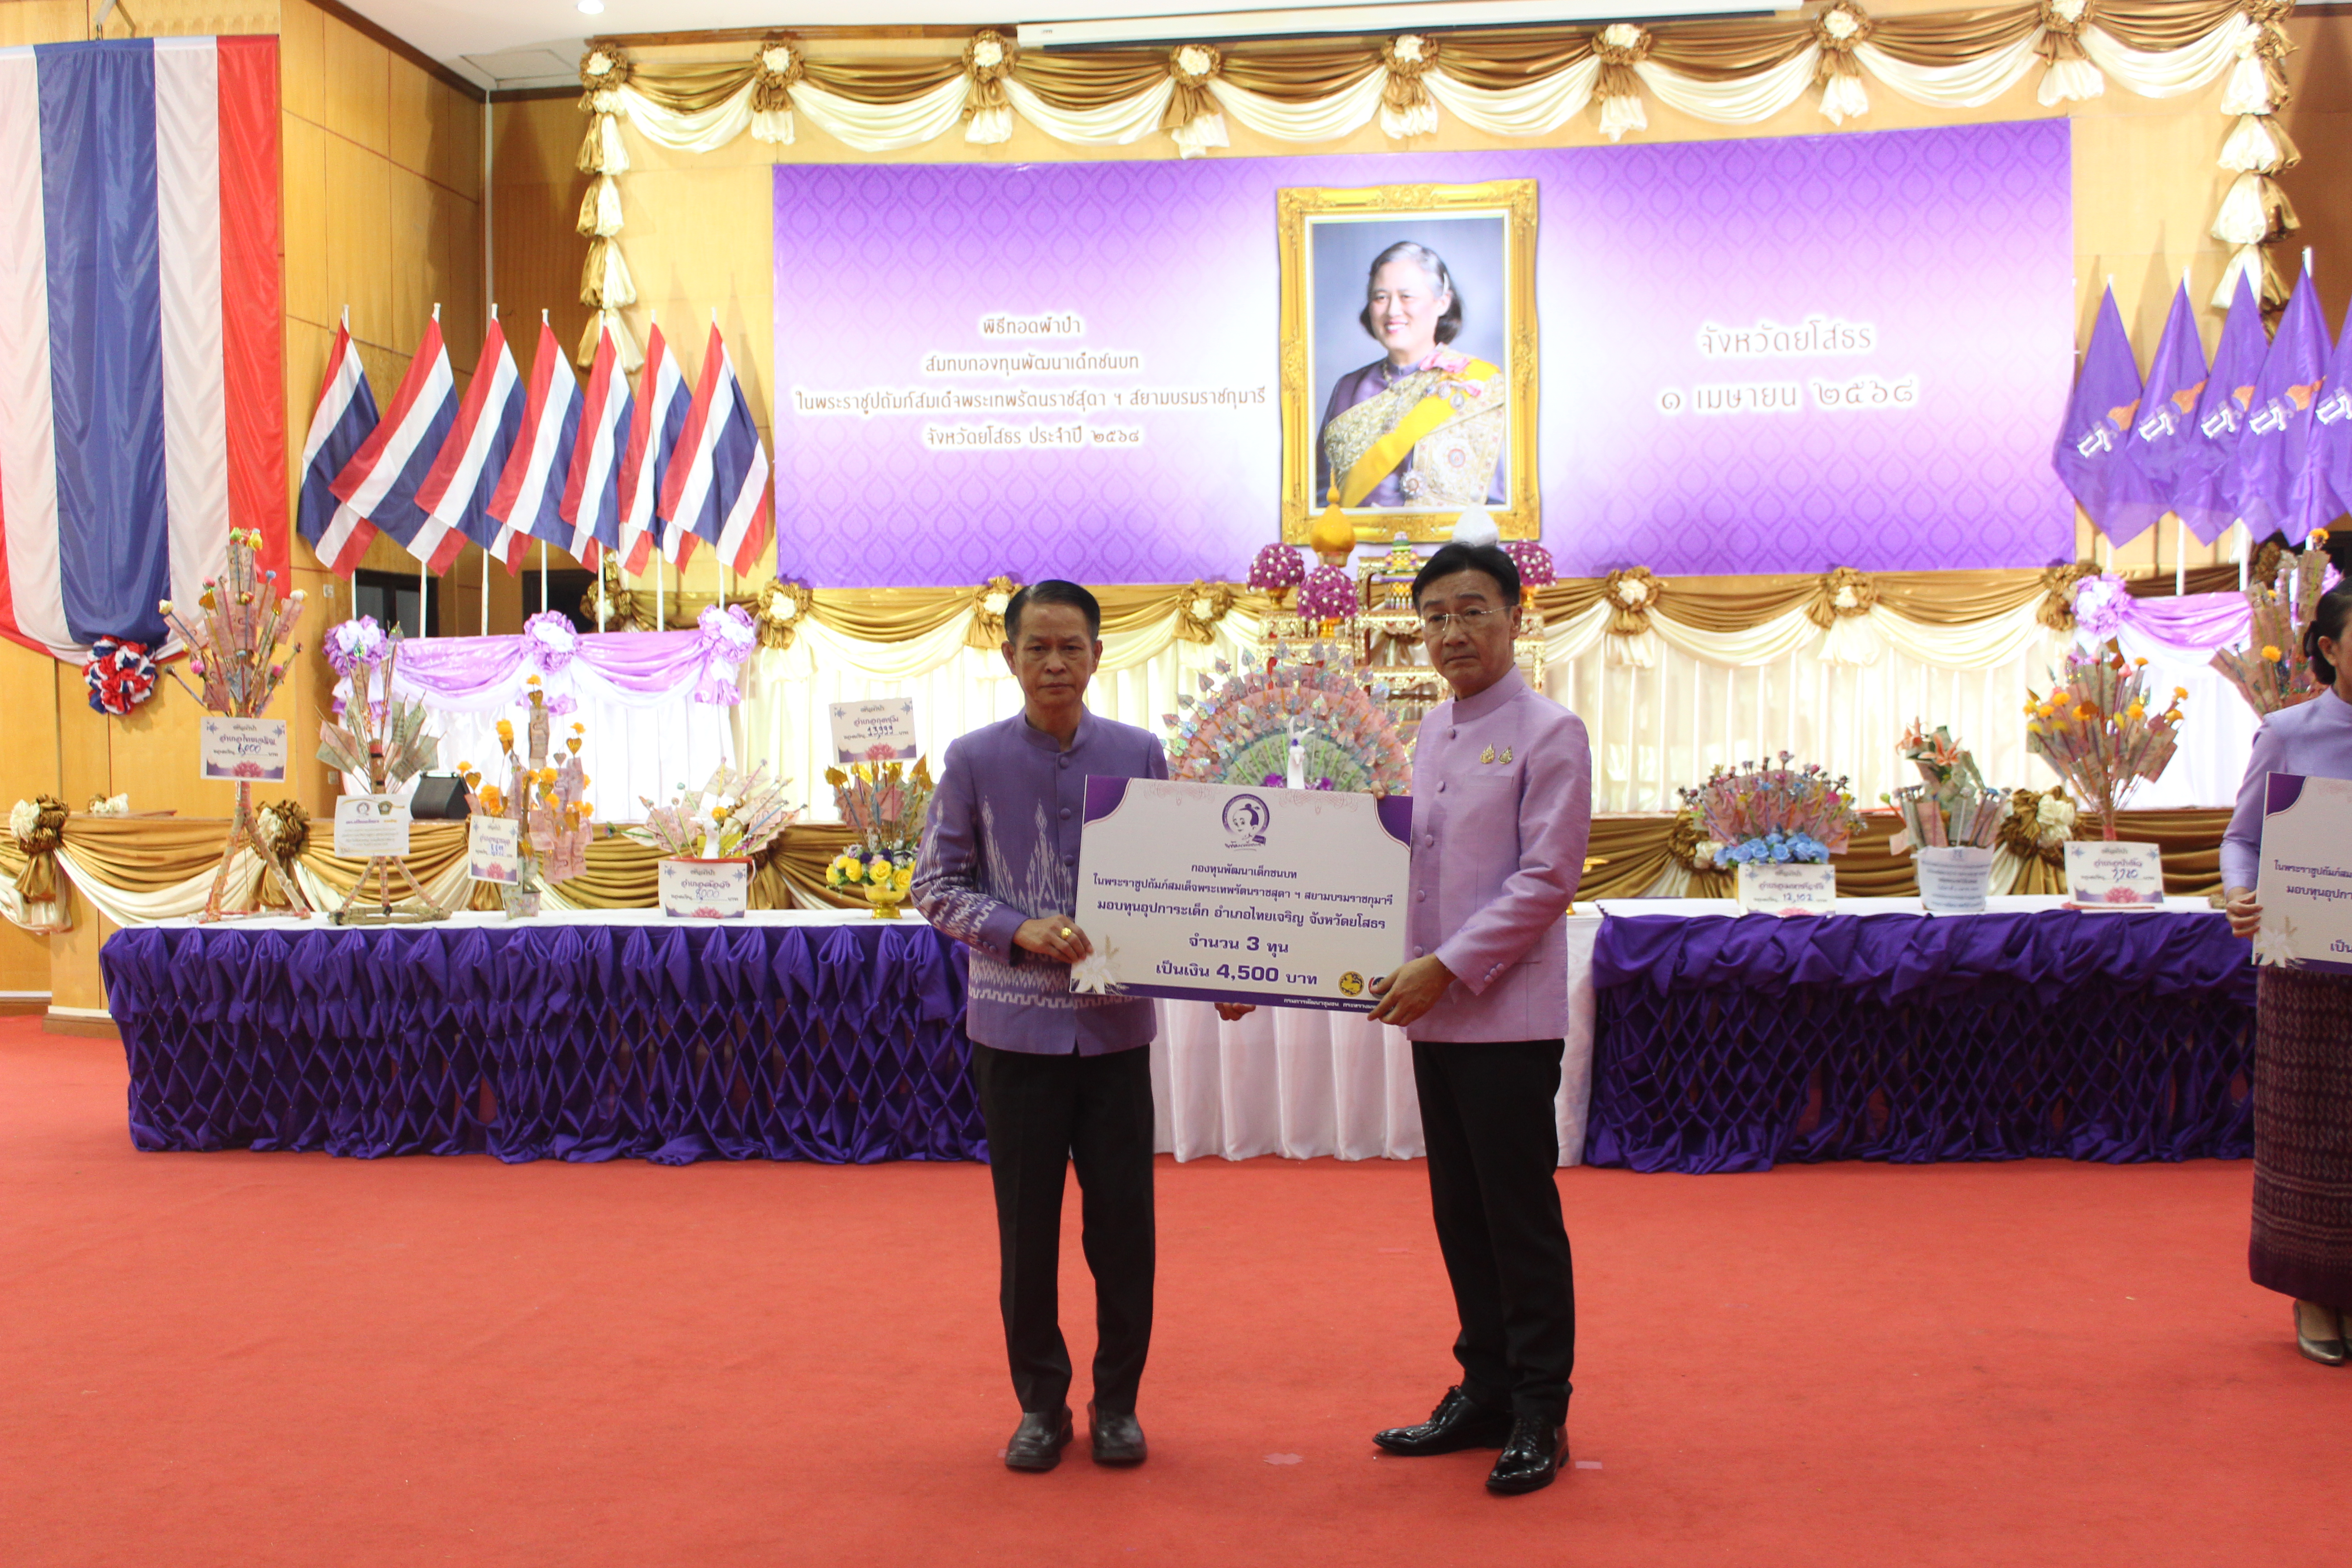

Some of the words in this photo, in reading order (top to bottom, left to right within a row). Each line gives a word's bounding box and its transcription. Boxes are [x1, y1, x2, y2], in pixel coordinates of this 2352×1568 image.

[983, 316, 1081, 335] พิธีทอดผ้าป่า
[1701, 319, 1872, 353] จังหวัดยโสธร
[926, 352, 1139, 376] สมทบกองทุนพัฒนาเด็กชนบท
[796, 388, 1106, 414] ในพระราชูปถัมภ์สมเด็จพระเทพรัตนราชสุดา
[1114, 394, 1122, 406] ฯ
[1130, 386, 1266, 409] สยามบรมราชกุมารี
[1661, 392, 1681, 410] ๑
[1697, 386, 1797, 409] เมษายน
[1813, 379, 1913, 405] ๒๕๖๘
[927, 426, 1021, 445] จังหวัดยโสธร
[1029, 426, 1083, 444] ประจำปี
[1090, 429, 1139, 443] ๒๕๖๘
[1191, 863, 1297, 879] กองทุนพัฒนาเด็กชนบท
[1093, 872, 1290, 902] ในพระราชูปถัมภ์สมเด็จพระเทพรัตนราชสุดา
[1304, 891, 1393, 908] สยามบรมราชกุมารี
[1097, 900, 1209, 917] มอบทุนอุปการะเด็ก
[1215, 905, 1304, 926] อำเภอไทยเจริญ
[1309, 911, 1385, 929] จังหวัดยโสธร
[1189, 932, 1239, 949] จำนวน
[1247, 936, 1259, 951] 3
[1267, 942, 1289, 958] ทุน
[1156, 960, 1209, 977] เป็นเงิน
[1216, 964, 1279, 982] 4,500
[1286, 974, 1317, 985] บาท
[1284, 999, 1339, 1008] กรมการพัฒนาชุมชน
